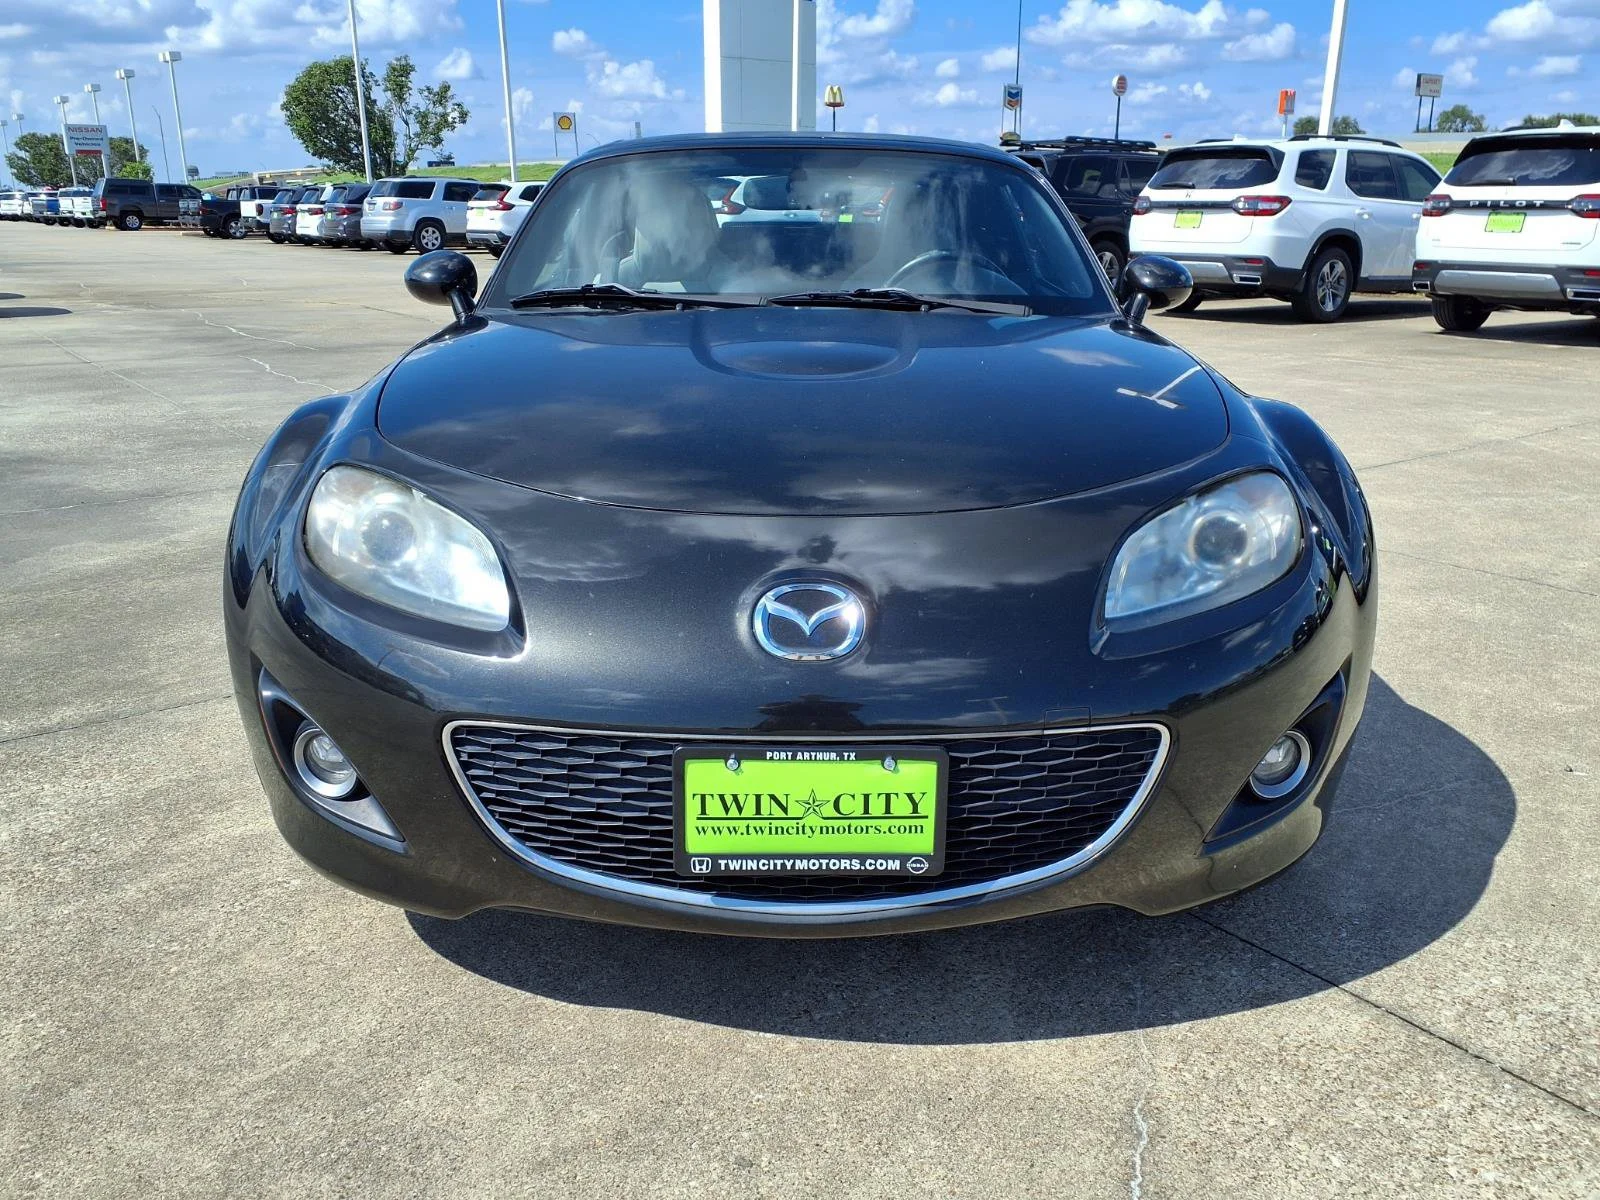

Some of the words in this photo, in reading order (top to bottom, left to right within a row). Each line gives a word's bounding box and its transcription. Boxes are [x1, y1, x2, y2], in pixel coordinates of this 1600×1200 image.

[766, 751, 793, 760] PORT
[842, 752, 856, 761] TX
[692, 792, 791, 817] TWIN
[832, 791, 928, 816] CITY
[694, 821, 925, 839] www.twincitymotors.com
[717, 858, 901, 872] TWINCITYMOTORS.COM
